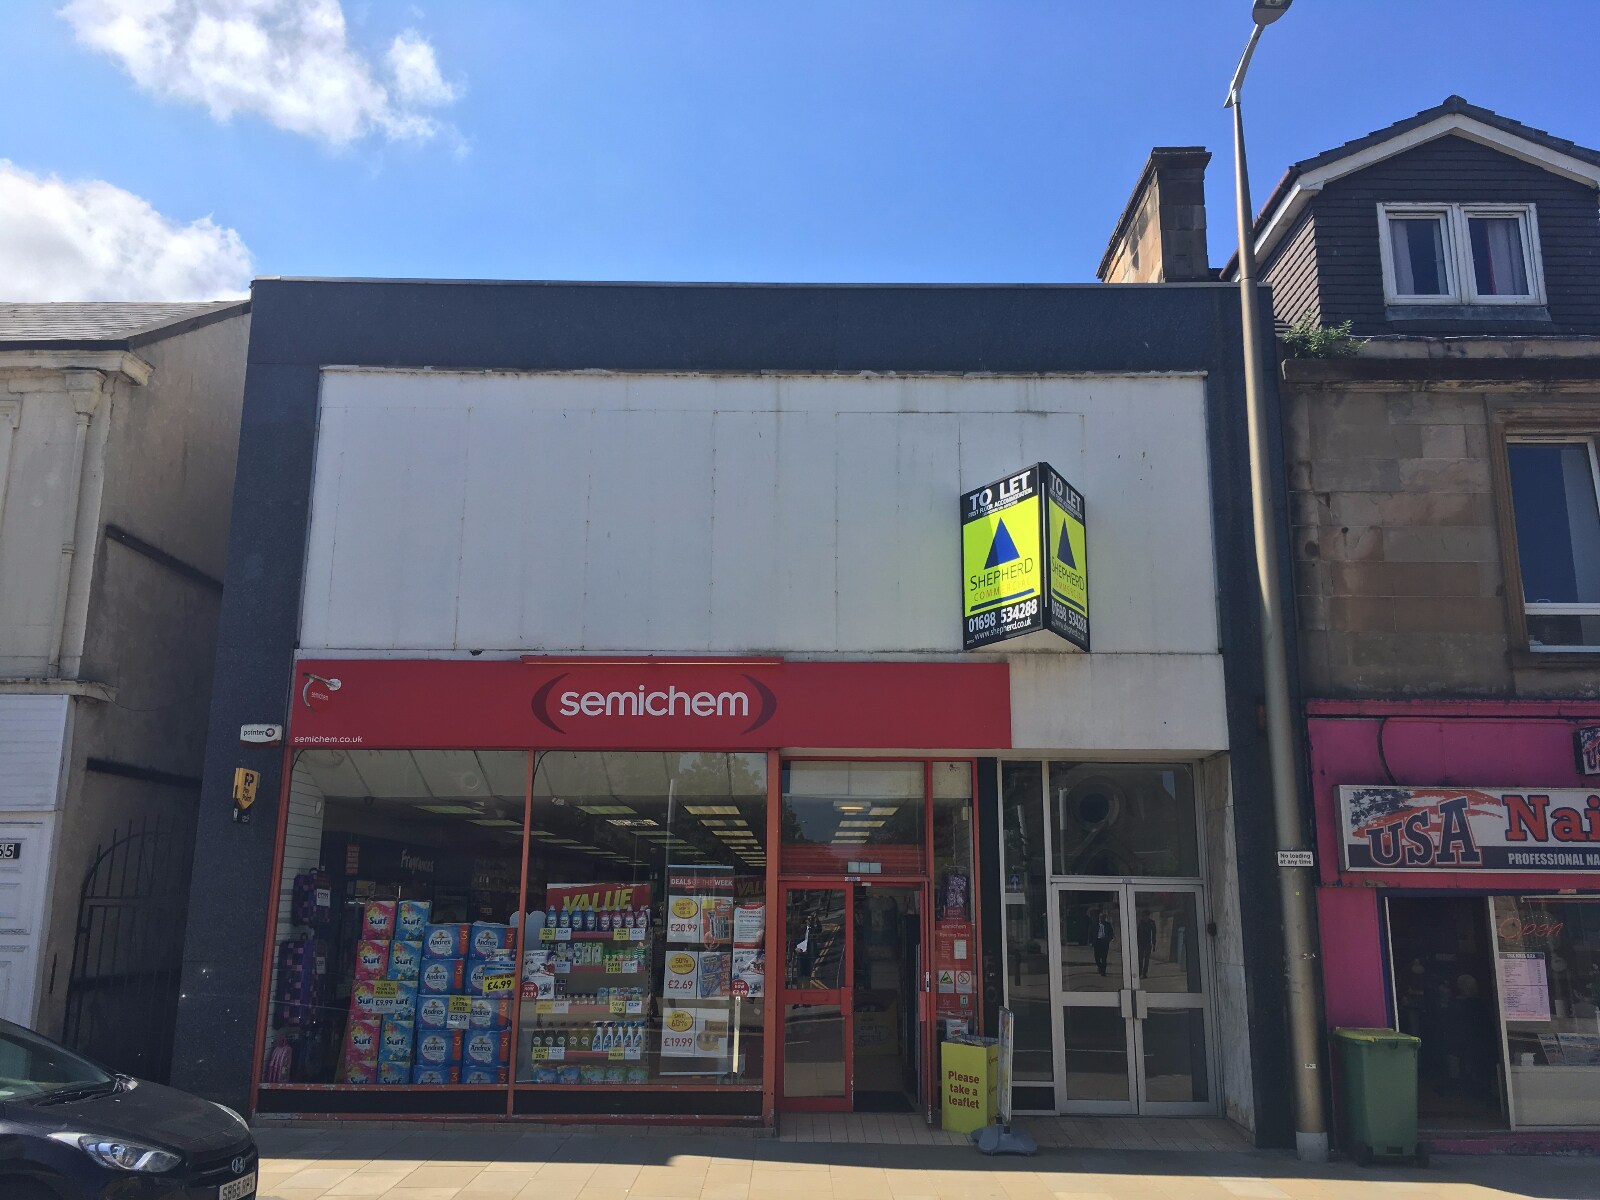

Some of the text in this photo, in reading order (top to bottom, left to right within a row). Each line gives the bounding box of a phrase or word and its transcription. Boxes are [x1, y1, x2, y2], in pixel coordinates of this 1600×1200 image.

[969, 488, 993, 511] TO
[999, 471, 1031, 500] LET
[1050, 471, 1063, 497] TO
[1066, 486, 1081, 512] LET
[970, 557, 1034, 591] SHEPHERD
[1051, 556, 1085, 591] SHEPHERD
[973, 578, 1031, 602] COMMERCIAL
[968, 598, 1038, 633] 01698 534288
[974, 617, 1032, 641] www.shepherd.co.uk
[311, 691, 329, 701] semichem
[559, 684, 749, 717] semichem
[243, 729, 265, 737] pointer
[294, 735, 363, 743] semichem.co.uk
[1365, 796, 1483, 866] USA
[1290, 852, 1311, 860] loading
[1508, 853, 1585, 866] PROFESSIONAL
[714, 879, 734, 887] WEEK
[563, 887, 634, 915] VALUE
[369, 917, 387, 925] Surf
[402, 917, 421, 926] Surf
[670, 923, 698, 932] £20.99
[461, 930, 468, 940] 3
[506, 933, 513, 943] 3
[476, 939, 497, 947] Andrex
[362, 956, 381, 964] Surf
[394, 956, 413, 966] Surf
[456, 965, 462, 975] 3
[487, 980, 512, 990] £4.99
[668, 979, 693, 989] £2.69
[375, 998, 393, 1006] £9.99
[395, 997, 408, 1006] urf
[500, 1001, 507, 1012] 3
[423, 1008, 444, 1016] Andrex
[353, 1036, 373, 1045] Surf
[386, 1036, 406, 1046] Surf
[454, 1036, 461, 1046] 3
[501, 1036, 508, 1047] 3
[663, 1037, 693, 1047] £19.99
[423, 1044, 445, 1052] Andrex
[470, 1044, 492, 1052] Andrex
[450, 1070, 458, 1081] 3
[499, 1071, 506, 1082] 3
[947, 1070, 980, 1084] Please
[949, 1083, 978, 1097] take a
[948, 1095, 980, 1109] leaflet
